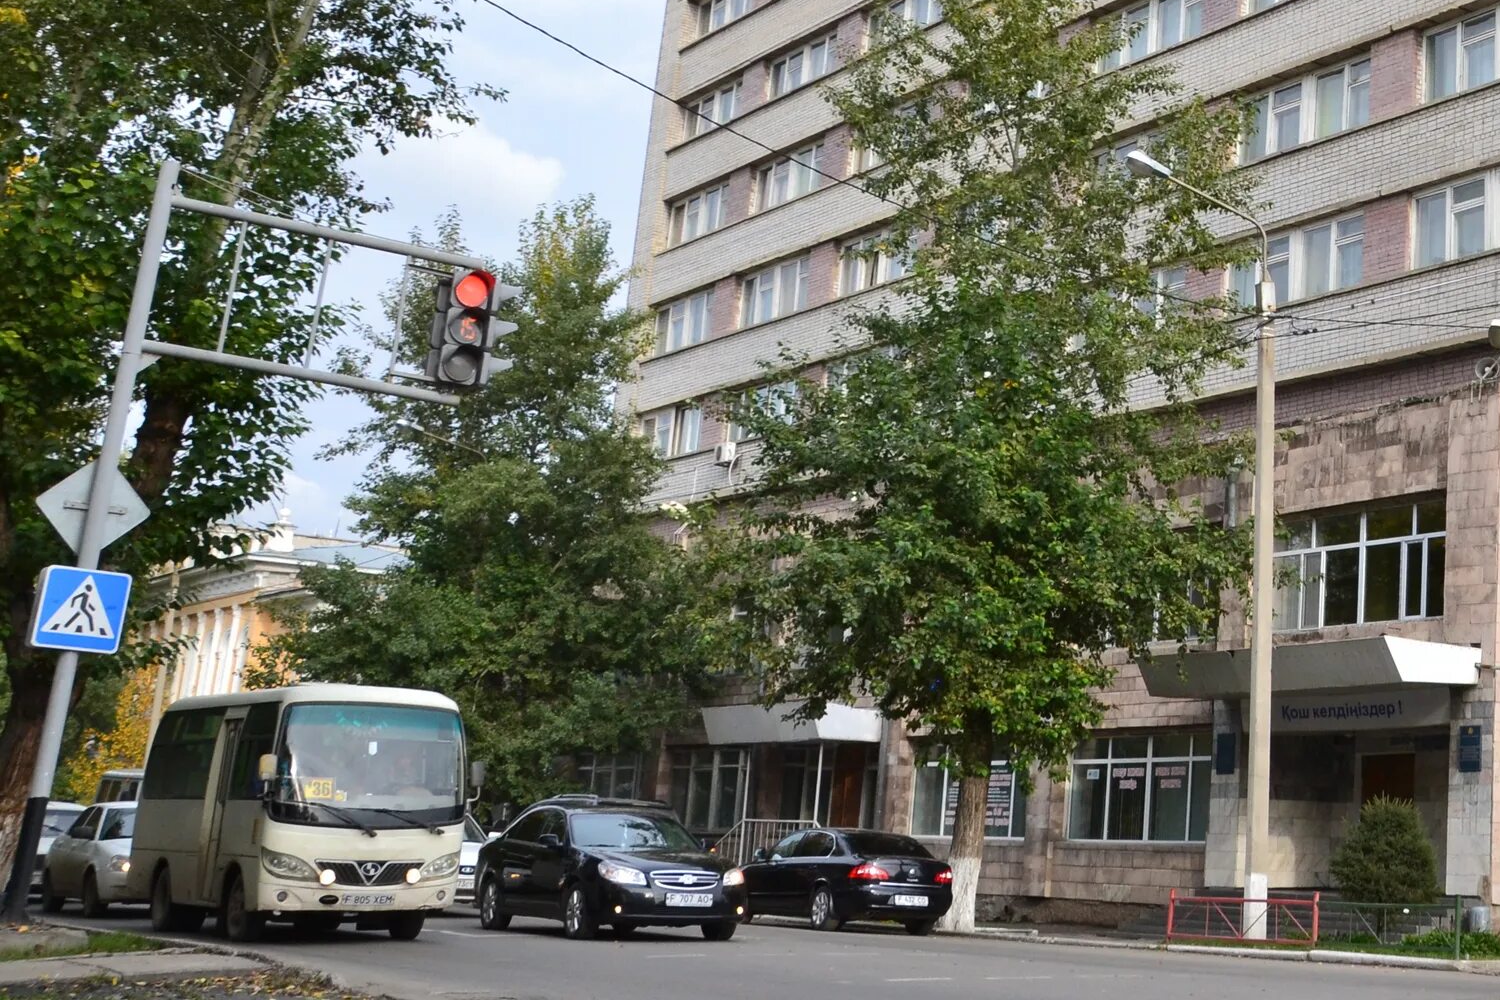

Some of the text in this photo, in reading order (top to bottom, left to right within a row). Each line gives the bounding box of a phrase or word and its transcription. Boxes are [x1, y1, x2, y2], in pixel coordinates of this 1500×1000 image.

[1281, 705, 1310, 721] Қош
[1312, 702, 1396, 720] келдіңіздер
[312, 781, 331, 797] 36
[354, 895, 371, 904] 805
[373, 895, 393, 904] XEM
[680, 894, 694, 903] 707
[697, 895, 709, 904] AO
